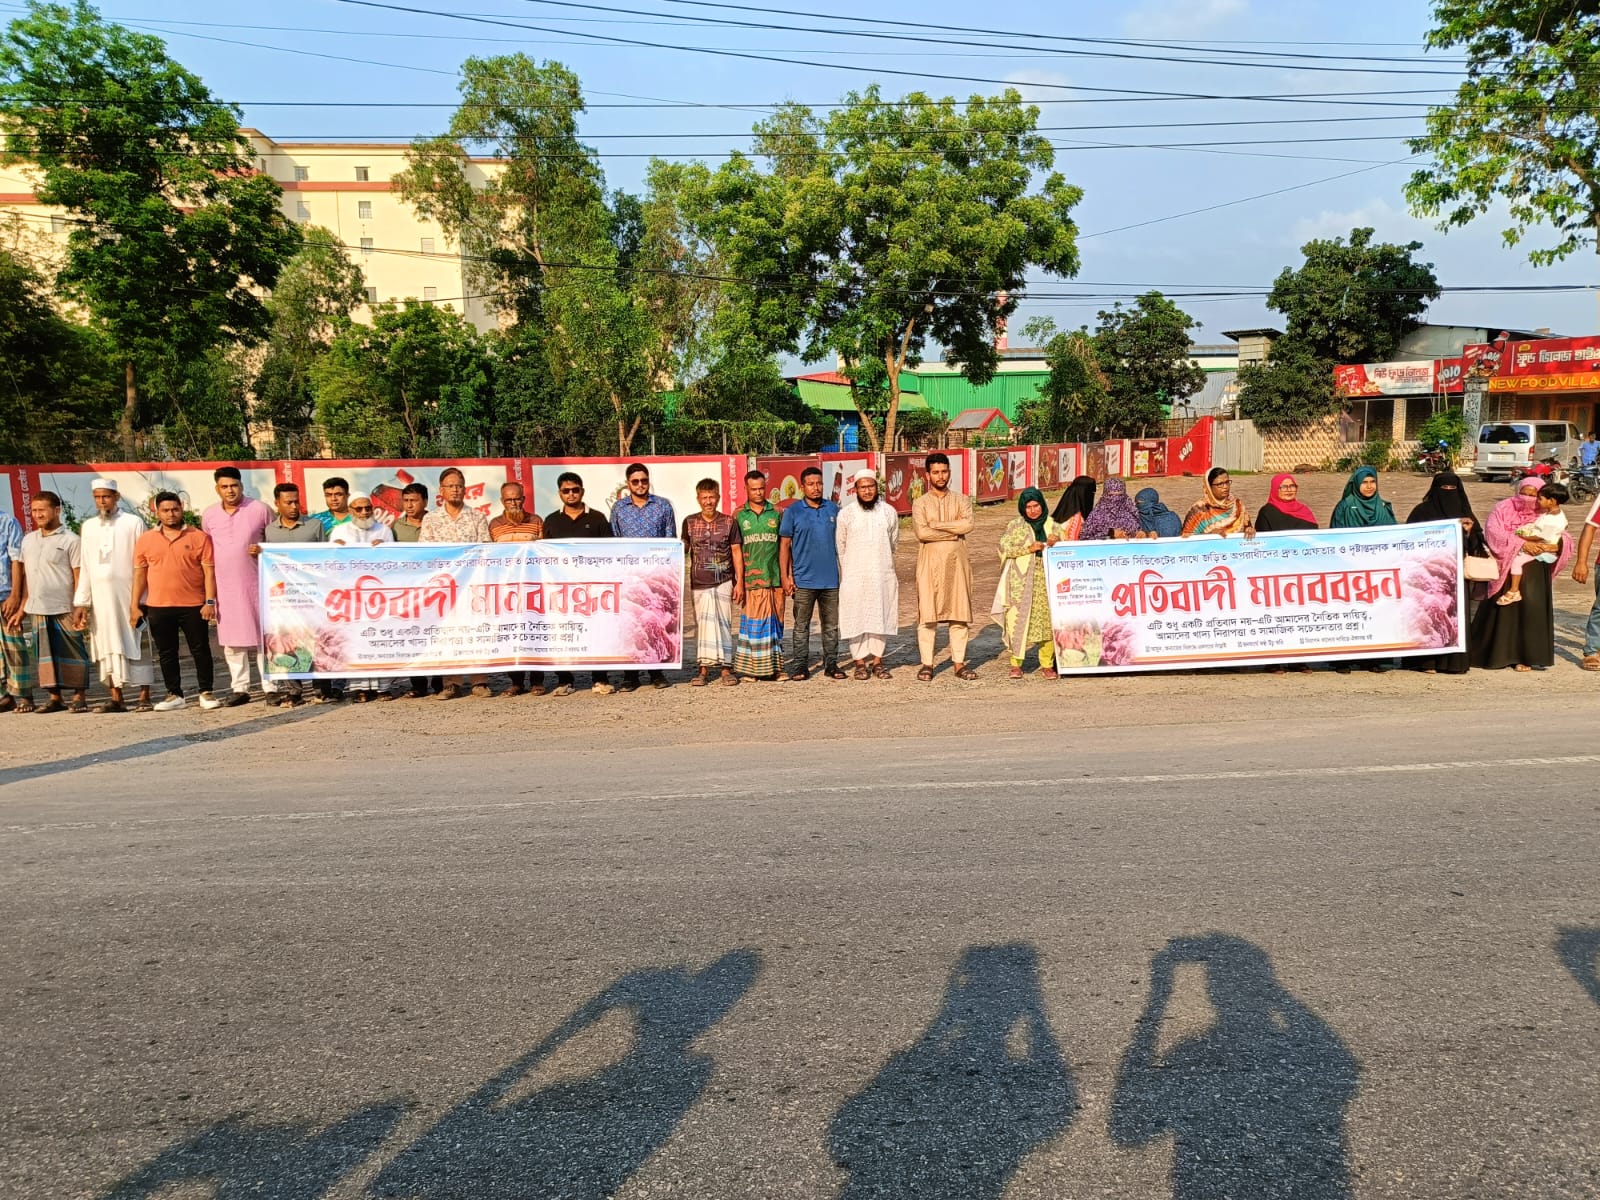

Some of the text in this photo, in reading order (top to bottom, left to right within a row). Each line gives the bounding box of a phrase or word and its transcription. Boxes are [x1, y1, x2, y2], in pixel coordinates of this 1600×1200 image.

[1488, 378, 1519, 389] NEW
[401, 561, 422, 570] সাথে
[563, 557, 569, 565] ও
[643, 554, 672, 566] দাবিতে
[1056, 560, 1084, 571] ঘোড়ার
[1087, 558, 1107, 568] মাংস
[1109, 556, 1131, 567] বিক্রি
[1179, 554, 1199, 564] সাথে
[1230, 548, 1278, 561] অপরাধীদের
[1339, 545, 1346, 554] ও
[1392, 540, 1415, 552] শাস্তির
[1417, 538, 1448, 550] দাবিতে
[325, 573, 459, 622] প্রতিবাদী
[470, 581, 623, 616] মানববন্ধন
[1111, 566, 1402, 617] প্রতিবাদী মানববন্ধন
[1147, 620, 1163, 631] এটি
[1166, 620, 1179, 631] শুধু
[1181, 618, 1203, 629] একটি
[1206, 617, 1237, 628] প্রতিবাদ
[1274, 614, 1310, 623] আমাদের
[1311, 610, 1340, 622] নৈতিক
[360, 627, 376, 637] এটি
[380, 628, 393, 638] শুধু
[396, 625, 420, 636] একটি
[1156, 631, 1190, 641] আমাদের
[1192, 630, 1211, 639] খাদ্য
[1213, 627, 1246, 638] নিরাপত্তা
[1259, 624, 1295, 634] সামাজিক
[1297, 623, 1342, 633] সচেতনতার
